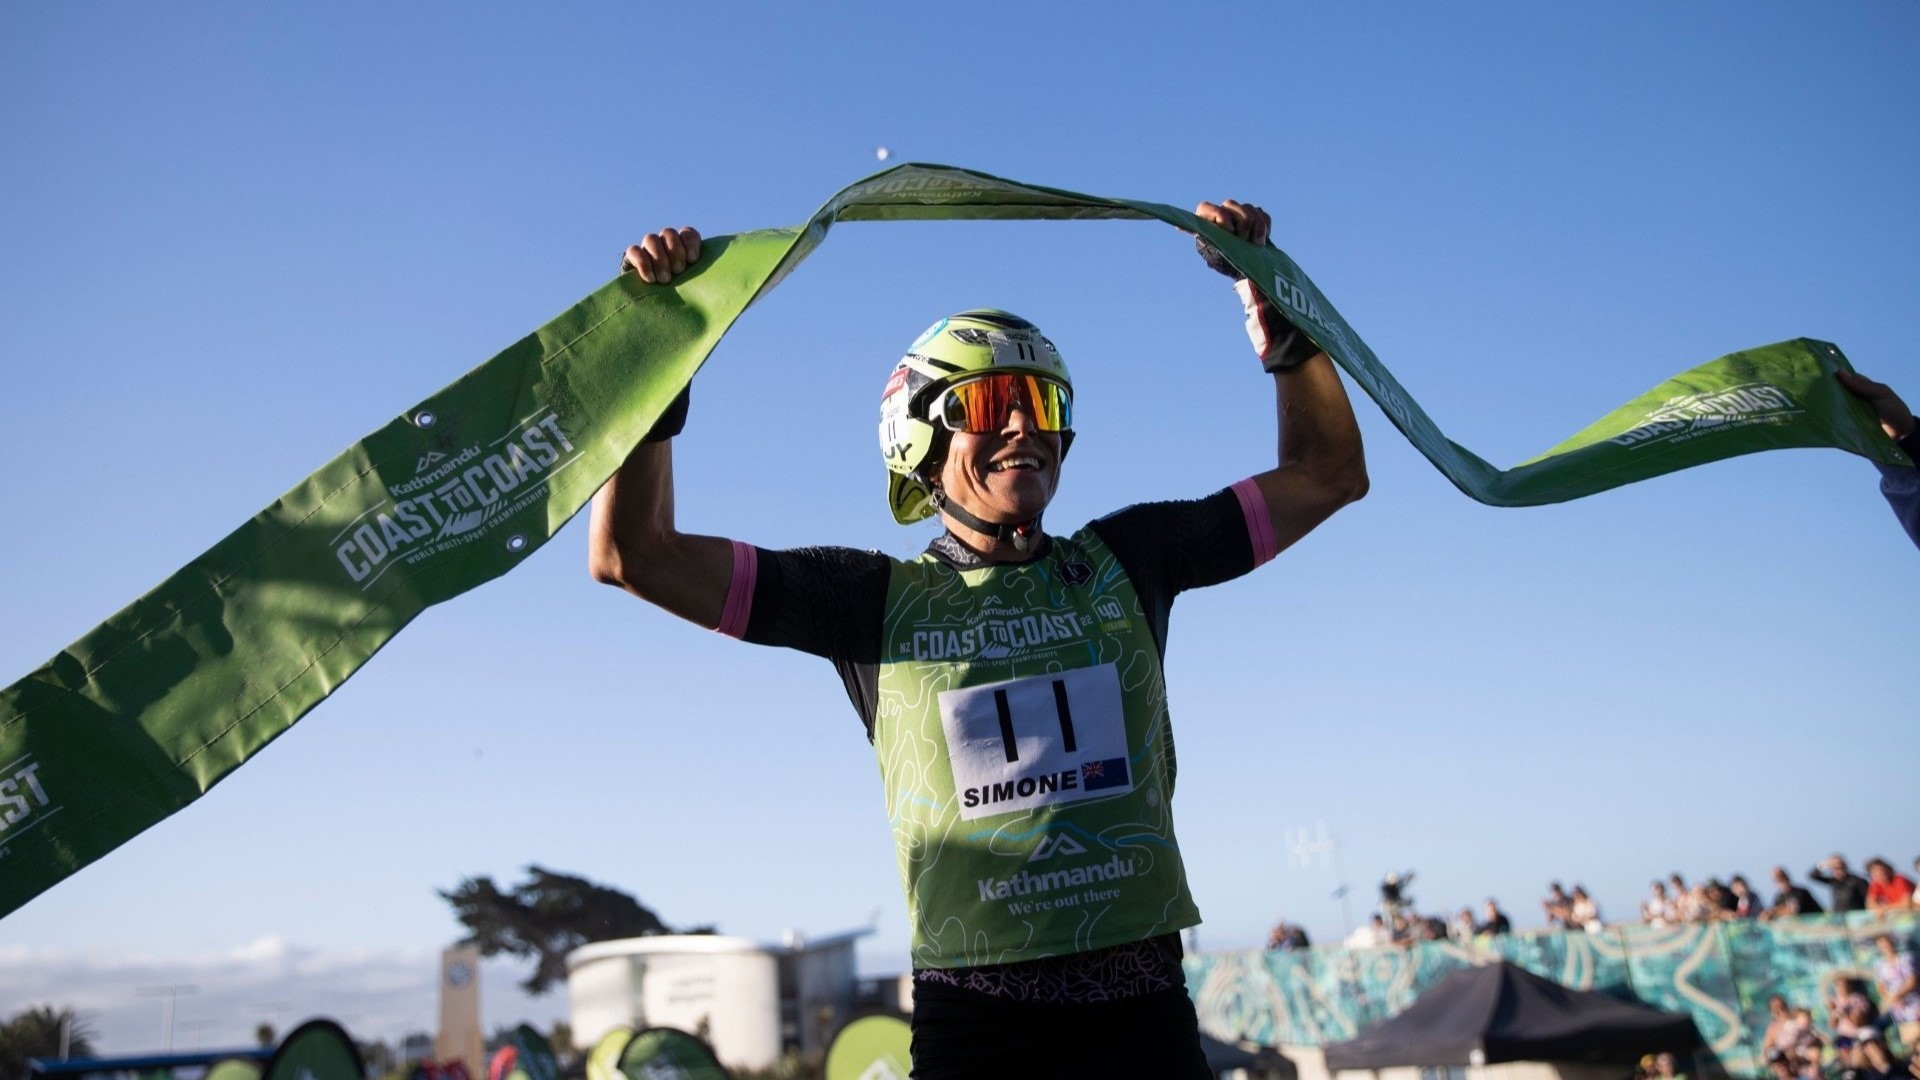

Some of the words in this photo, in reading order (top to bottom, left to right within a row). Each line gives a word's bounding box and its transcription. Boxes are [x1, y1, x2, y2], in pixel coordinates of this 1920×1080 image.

[1017, 343, 1036, 361] 11
[1703, 386, 1794, 415] COAST
[389, 445, 482, 497] Kathmandu
[337, 491, 444, 582] COAST
[441, 485, 474, 513] TO
[463, 413, 575, 507] COAST
[407, 546, 436, 565] WORLD
[437, 526, 488, 552] MULTI-SPORT
[488, 486, 549, 529] CHAMPIONSHIPS
[900, 642, 912, 653] NZ
[913, 621, 987, 662] COAST
[990, 626, 1009, 643] TO
[1006, 612, 1084, 649] COAST
[1080, 615, 1093, 627] 22
[967, 606, 1024, 626] Kathmandu
[993, 680, 1078, 763] 11
[0, 762, 50, 832] ST
[963, 769, 1078, 808] SIMONE
[977, 854, 1135, 902] Kathmandu
[1008, 898, 1051, 917] We're
[1054, 895, 1081, 909] out
[1083, 887, 1121, 902] there
